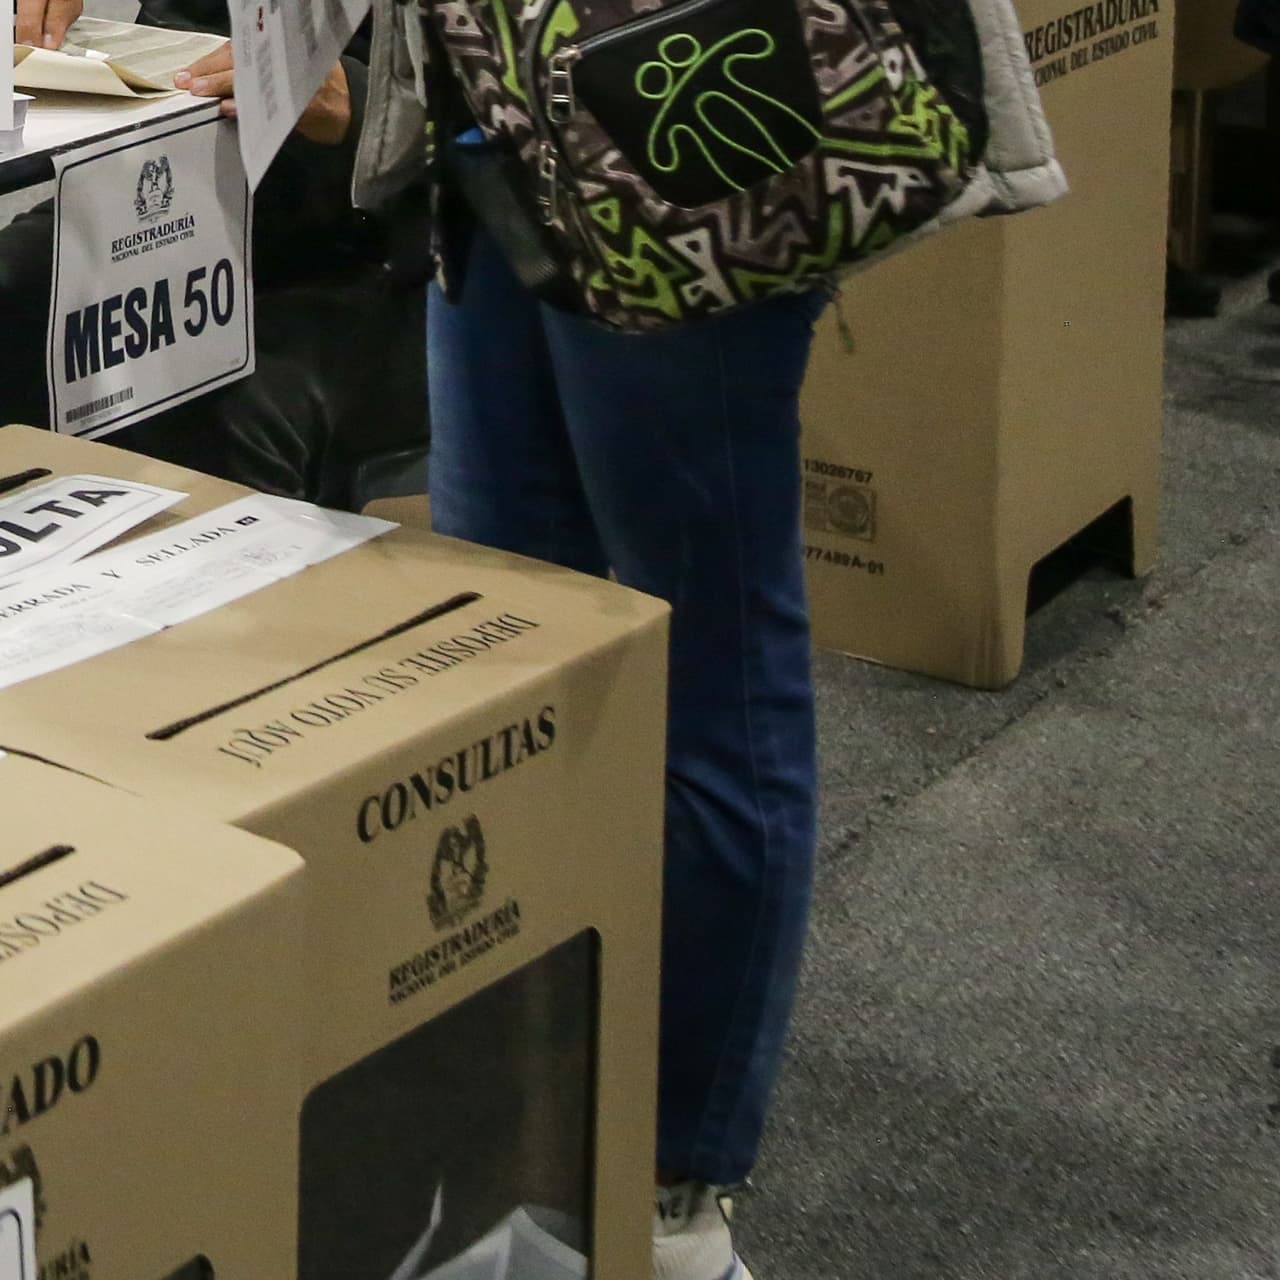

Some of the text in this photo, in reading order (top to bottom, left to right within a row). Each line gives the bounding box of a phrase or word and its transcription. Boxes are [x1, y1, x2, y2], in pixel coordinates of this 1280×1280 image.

[1034, 55, 1068, 89] CIONAL
[111, 212, 195, 254] REGISTRADURÍA
[65, 258, 234, 384] MESA 50
[100, 569, 124, 580] Y
[217, 613, 541, 769] DEPOSITE SU VOTO AQUÍ
[356, 705, 557, 845] CONSULTAS
